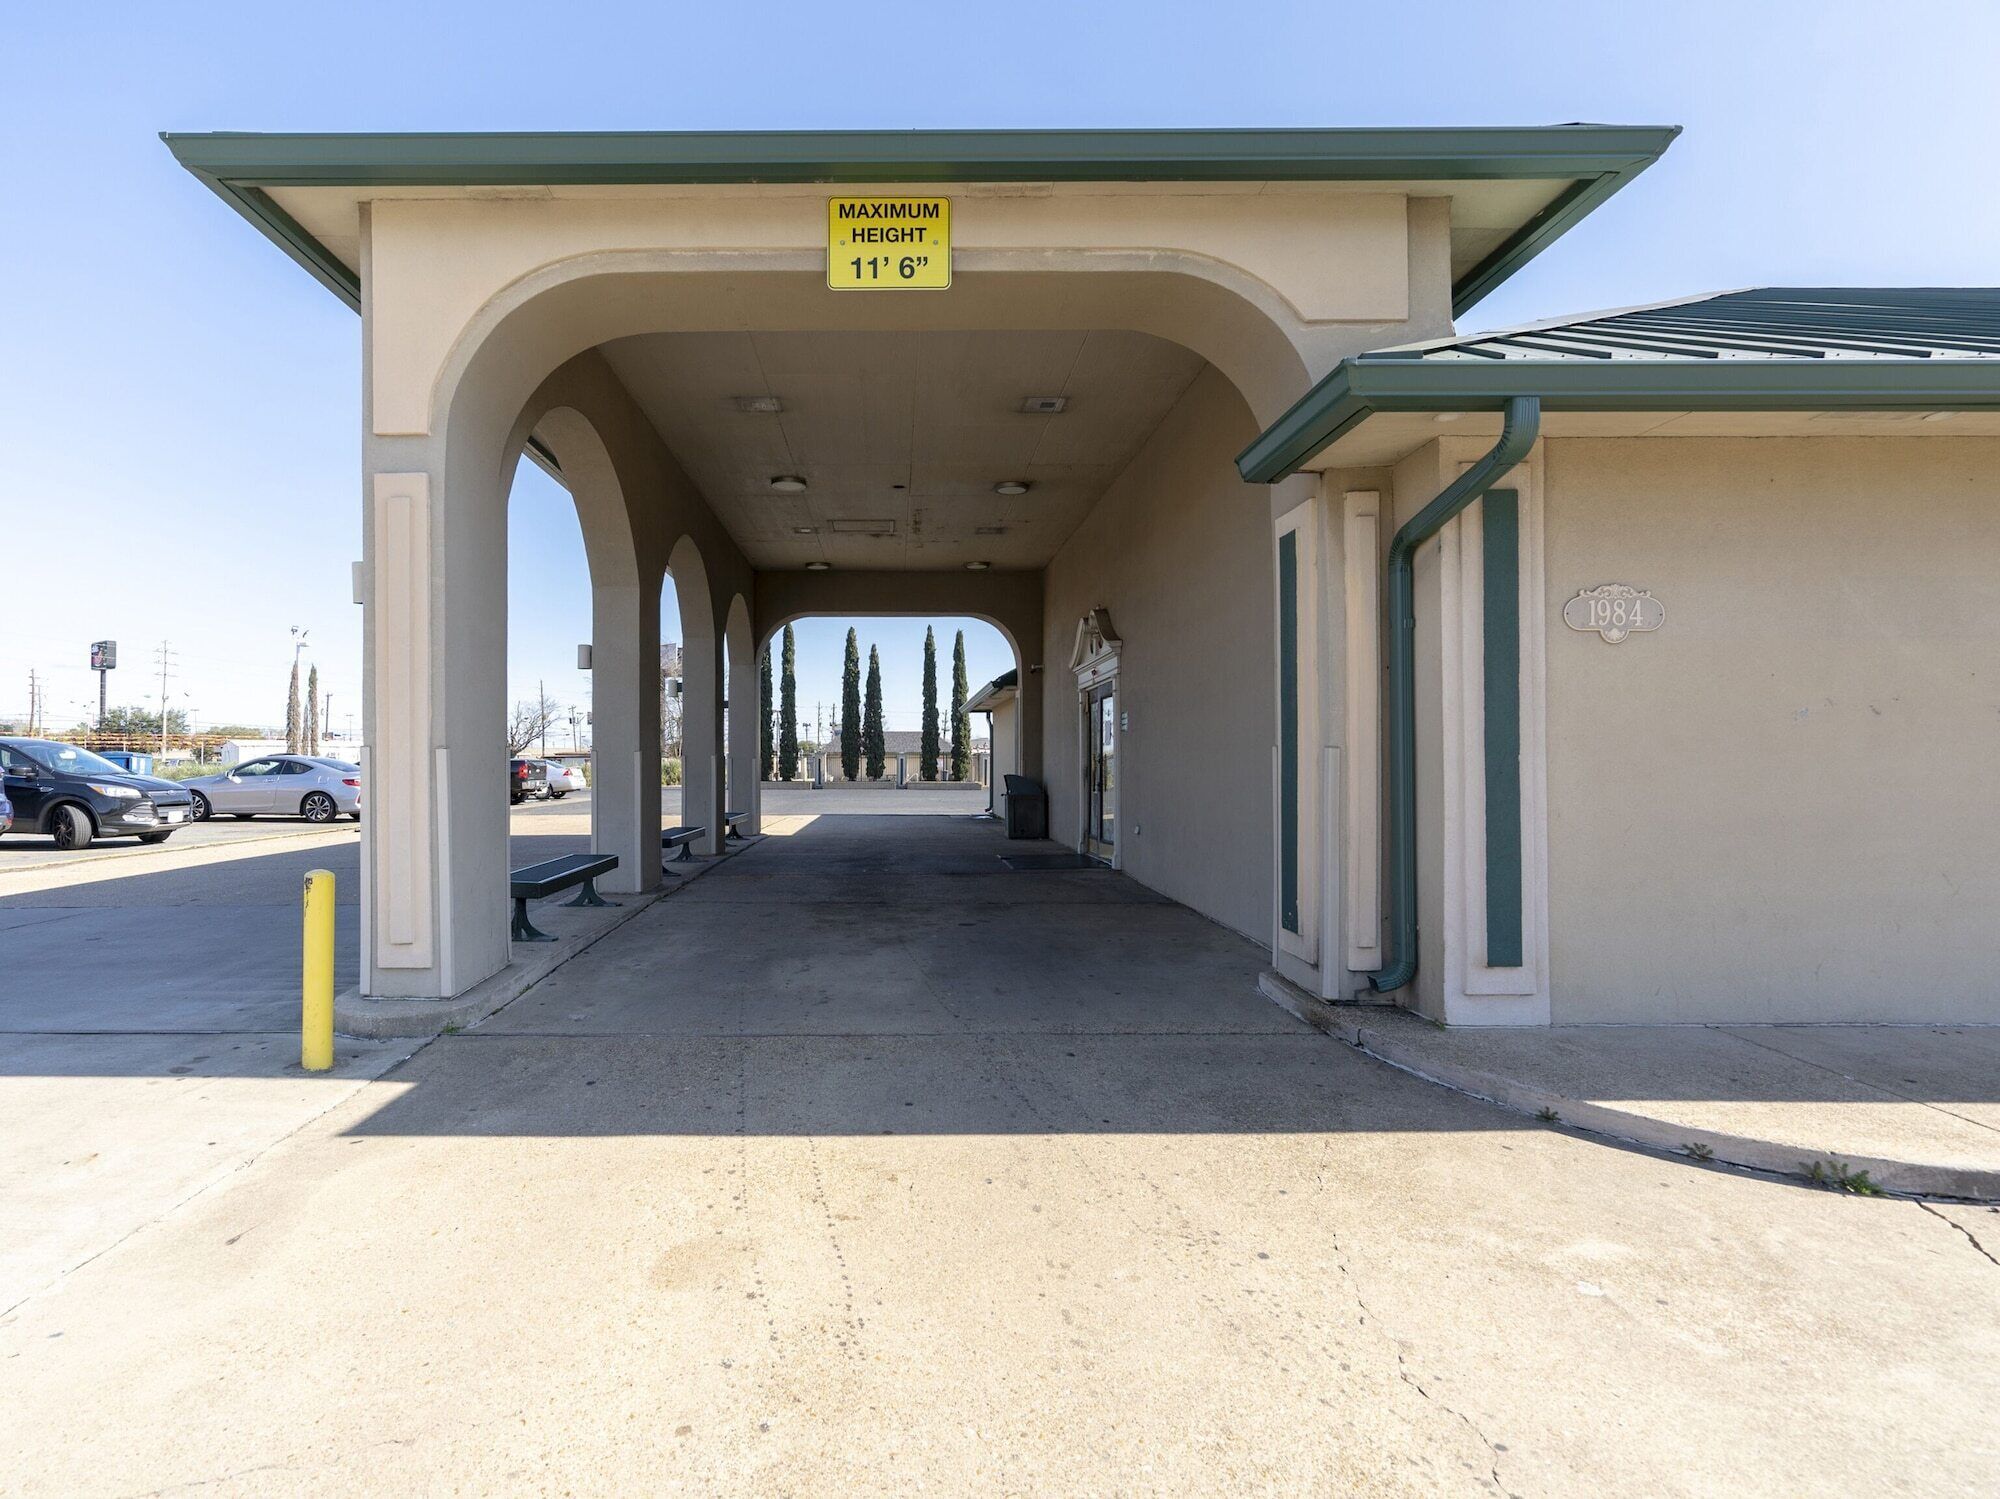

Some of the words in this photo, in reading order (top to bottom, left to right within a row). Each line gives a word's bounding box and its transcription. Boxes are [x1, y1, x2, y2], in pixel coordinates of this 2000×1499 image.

[838, 203, 940, 219] MAXIMUM
[851, 227, 928, 243] HEIGHT
[1588, 599, 1644, 626] 1984
